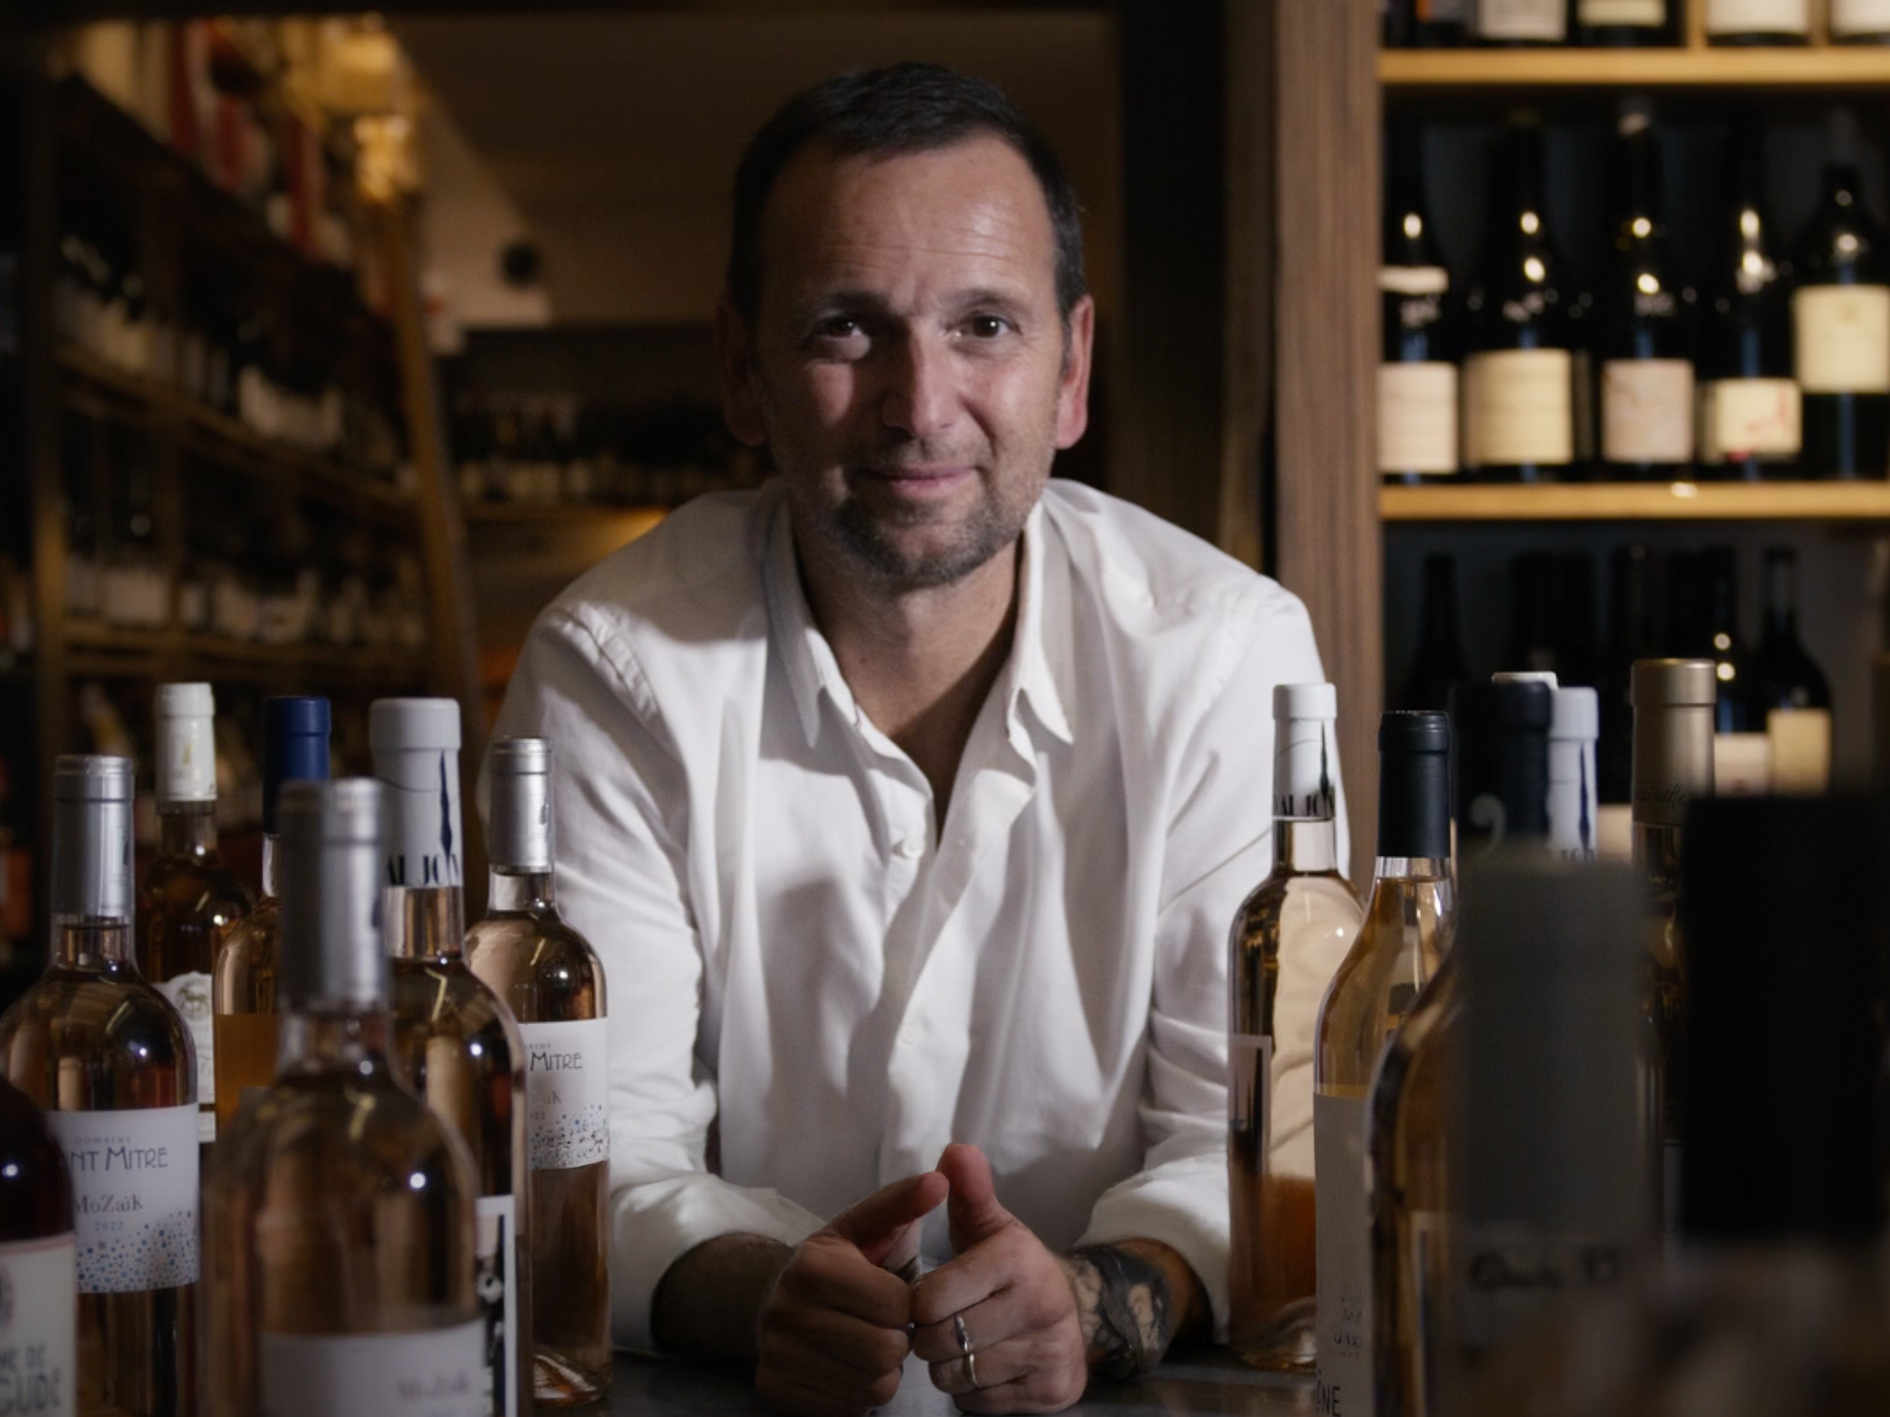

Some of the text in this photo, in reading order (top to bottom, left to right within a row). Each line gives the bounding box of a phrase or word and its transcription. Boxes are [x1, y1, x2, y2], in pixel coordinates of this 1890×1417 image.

[530, 1051, 582, 1071] MITRE
[70, 1146, 168, 1171] NT MITRE
[94, 1221, 123, 1231] 2022
